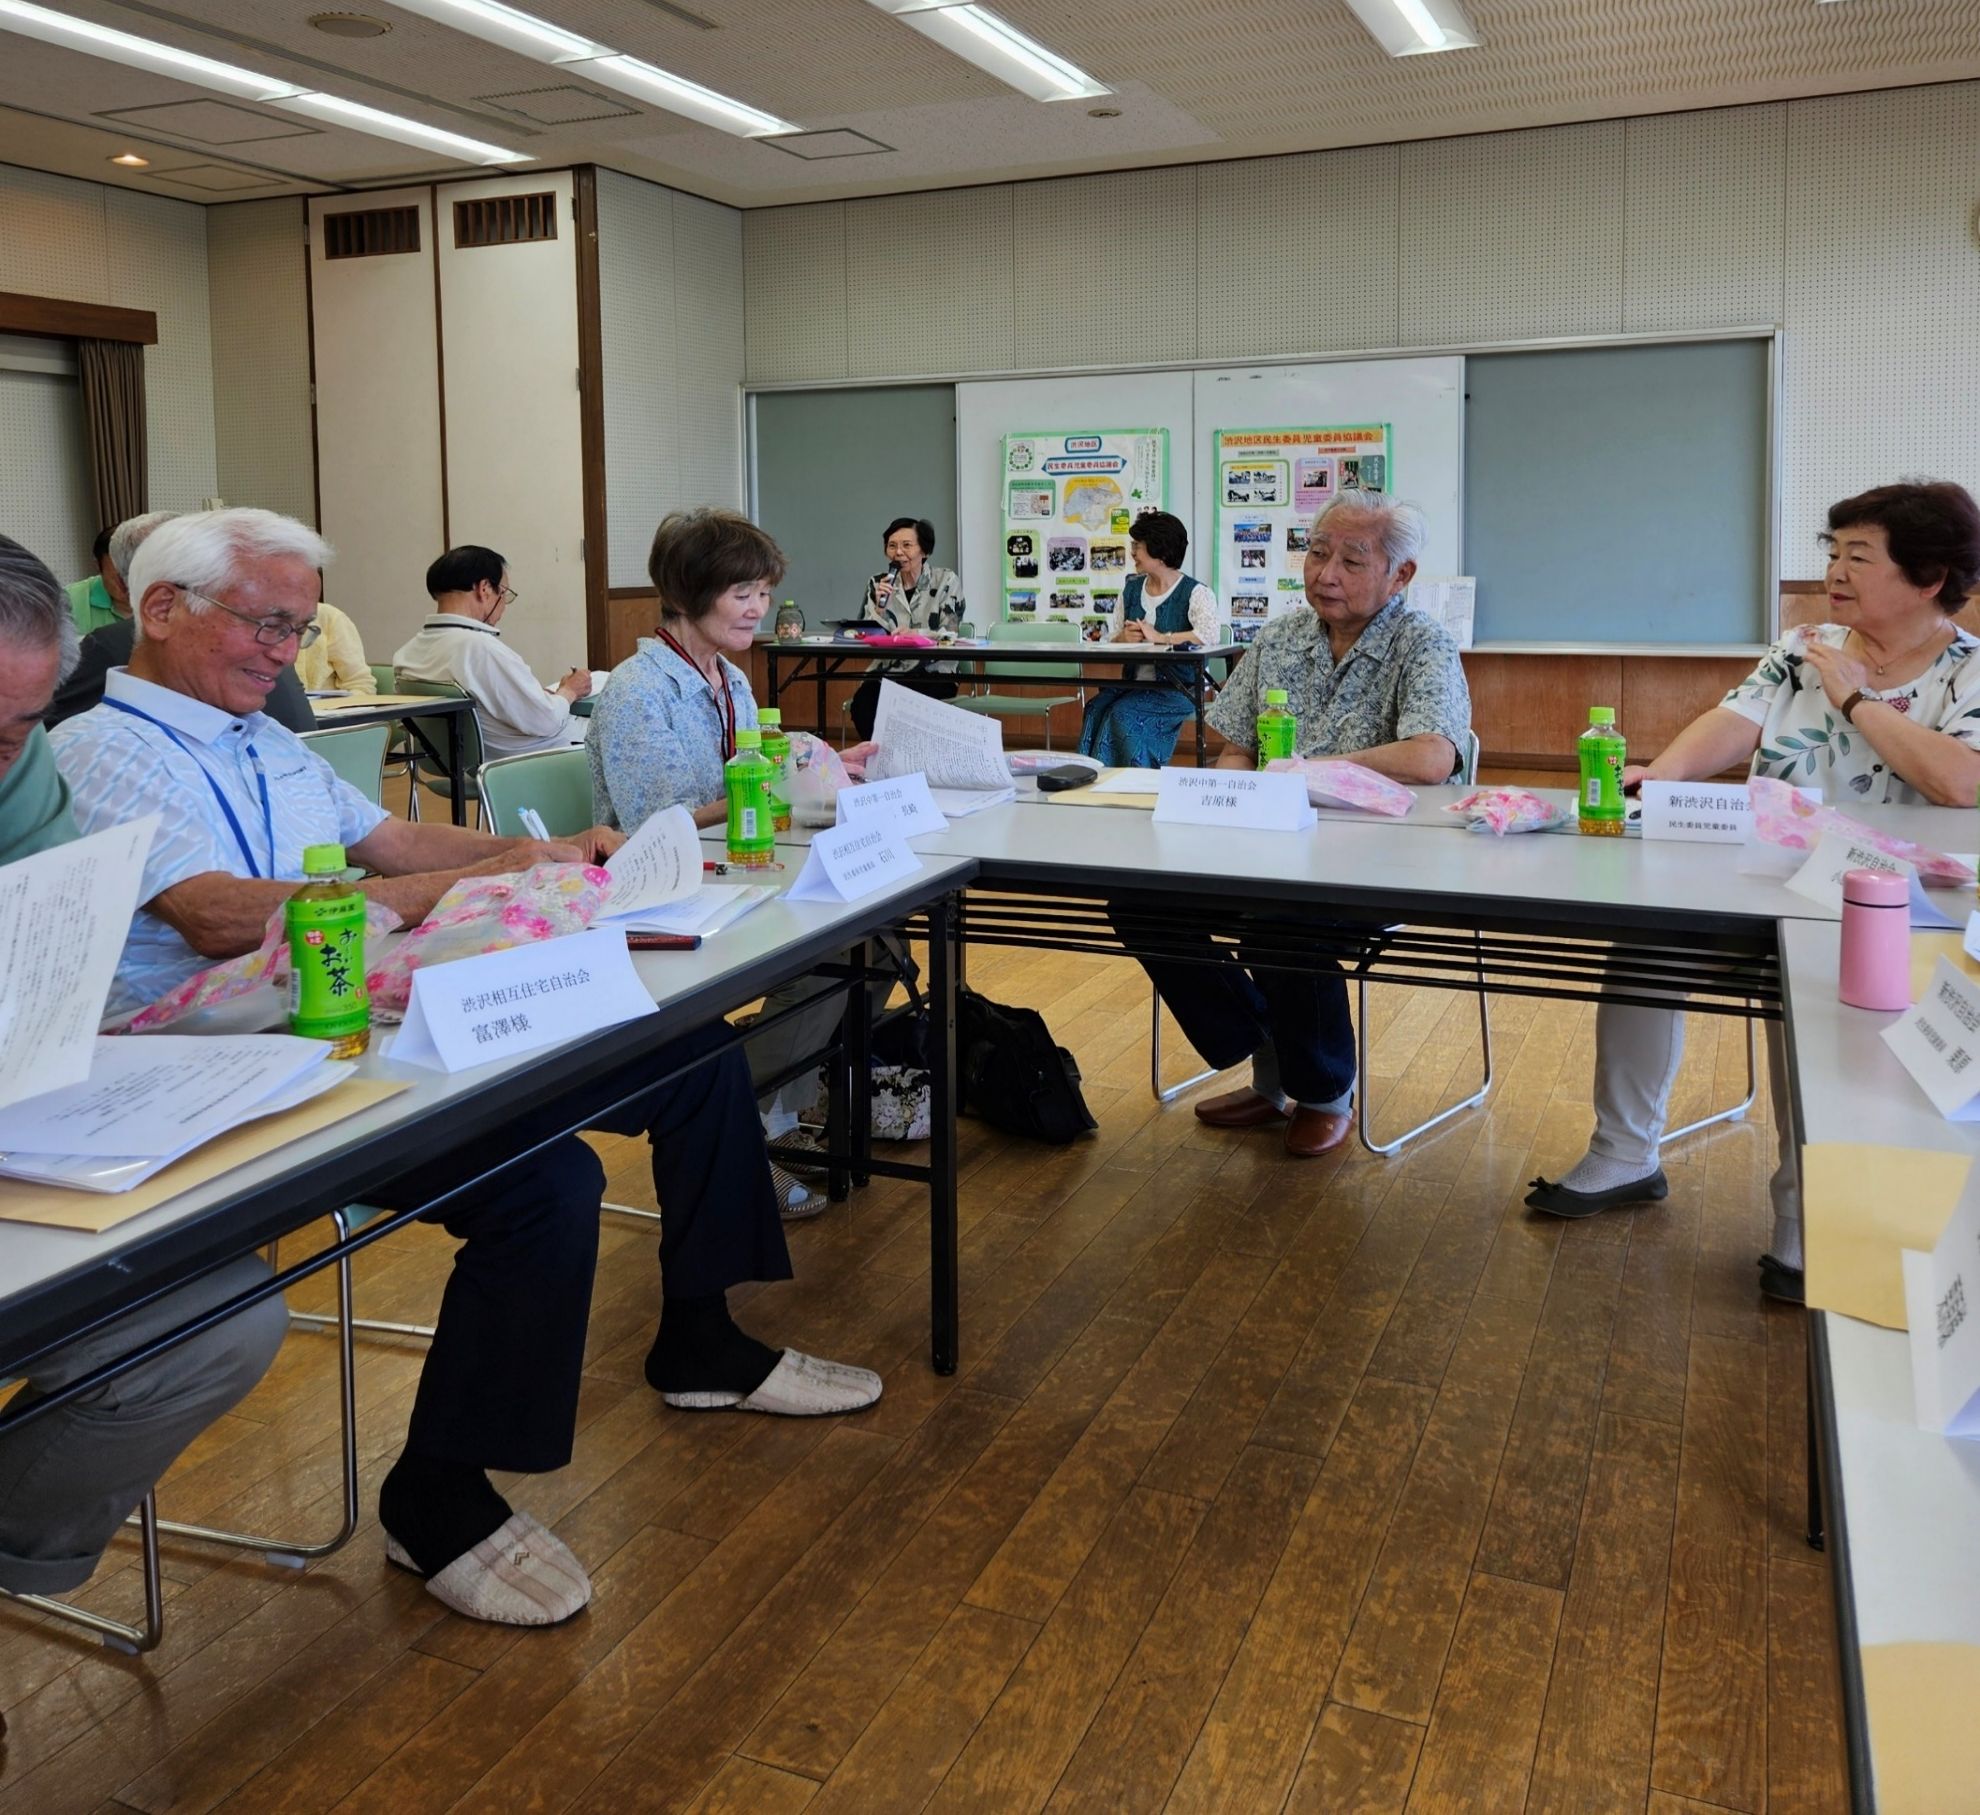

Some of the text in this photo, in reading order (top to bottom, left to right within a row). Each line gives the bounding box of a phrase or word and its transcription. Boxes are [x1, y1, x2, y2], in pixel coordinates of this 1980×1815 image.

[1224, 432, 1374, 446] 渋沢地区民生委員児童委員協議会
[1178, 776, 1257, 791] 渋沢中第一自治会
[1201, 795, 1238, 808] 吉原様
[1669, 795, 1752, 811] 新渋沢自治
[1669, 820, 1738, 832] 民生委員児童委員
[461, 968, 591, 1014] 渋沢相互住宅自治会
[472, 1013, 533, 1044] 富澤様
